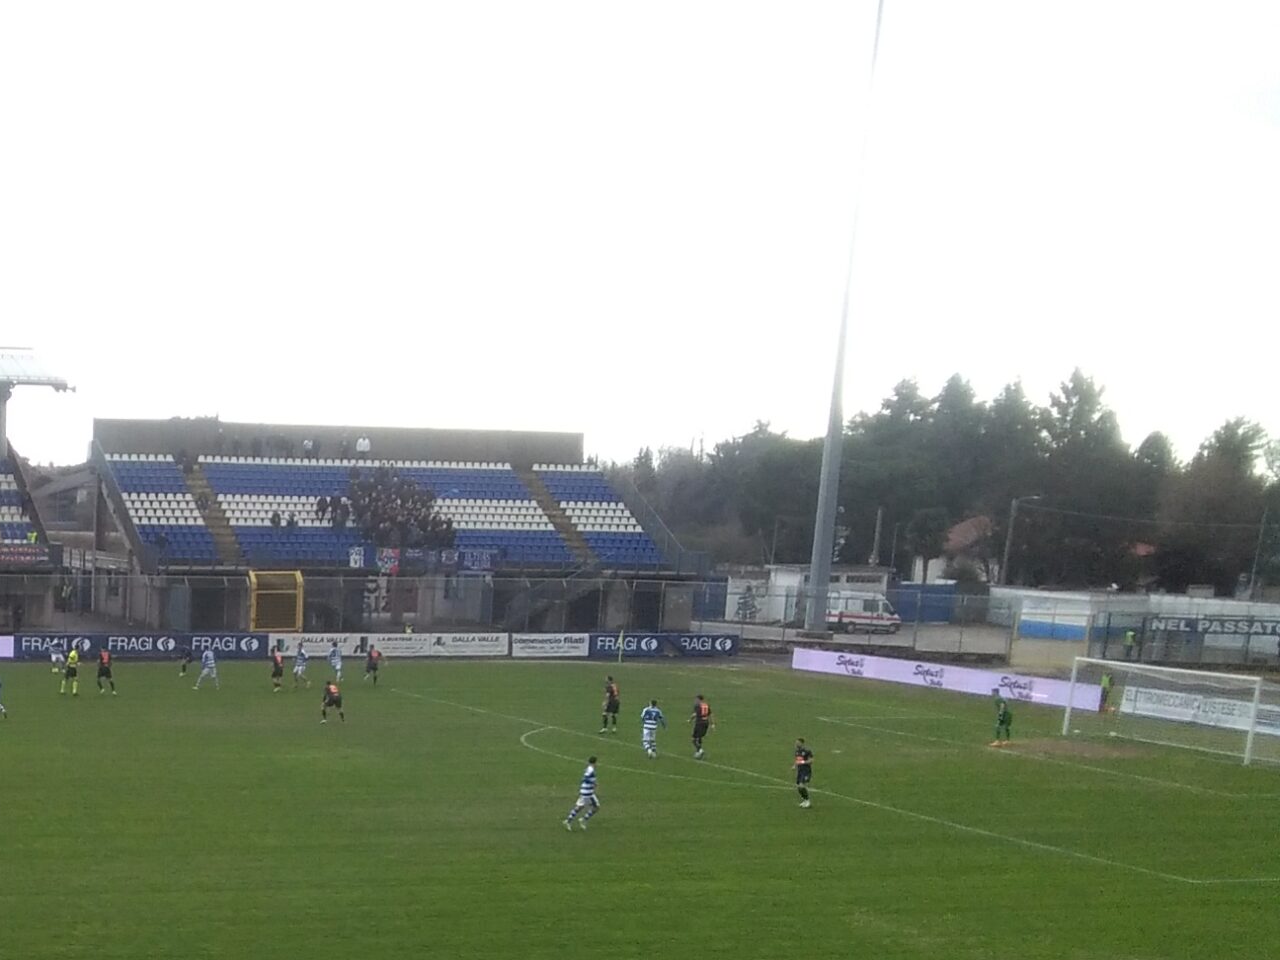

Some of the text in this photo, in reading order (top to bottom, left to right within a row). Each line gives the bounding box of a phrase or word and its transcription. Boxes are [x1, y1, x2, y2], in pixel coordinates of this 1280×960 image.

[1151, 618, 1191, 631] NEL
[22, 637, 67, 651] FRAI
[108, 637, 152, 651] FRAGI
[192, 637, 236, 651] FRAGI
[596, 637, 637, 651] FRAGI
[680, 637, 712, 651] RAGI
